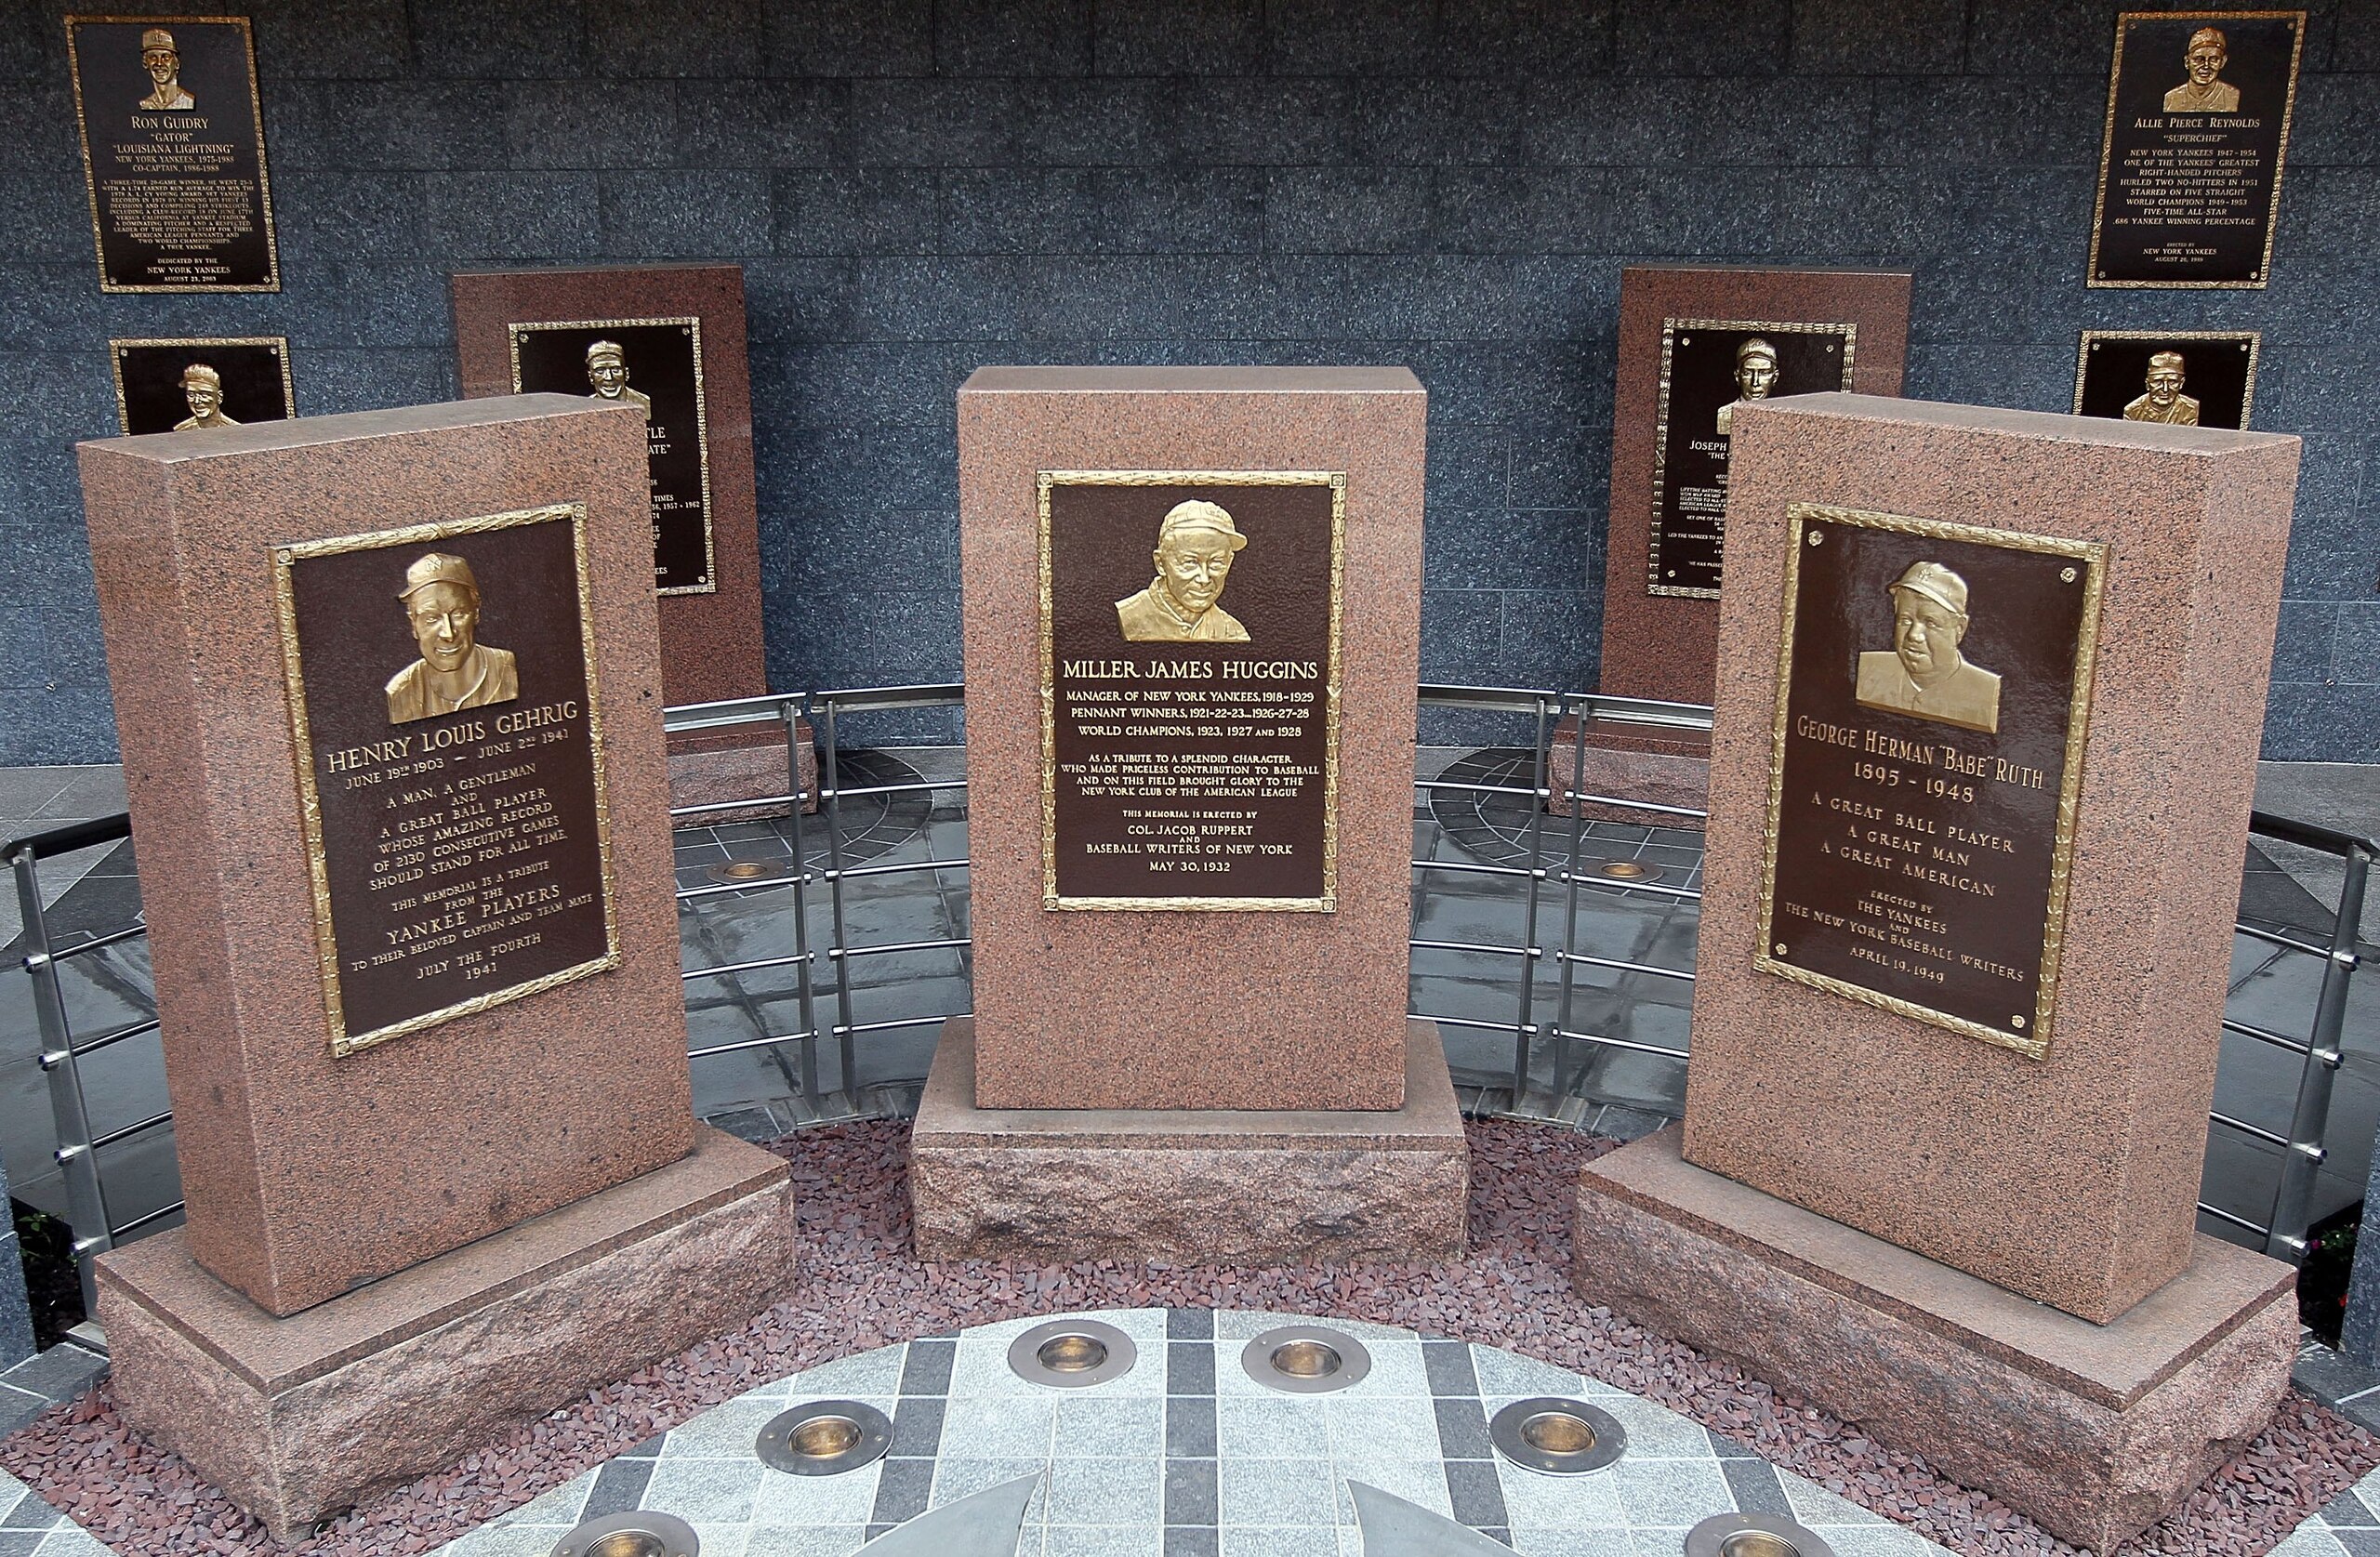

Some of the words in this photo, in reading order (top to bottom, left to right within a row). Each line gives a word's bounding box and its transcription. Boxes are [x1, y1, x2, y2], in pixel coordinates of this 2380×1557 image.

[131, 116, 158, 128] RON
[163, 116, 208, 129] GUIDRY
[2134, 117, 2162, 128] ALLIE
[2169, 117, 2203, 127] PIERCE
[2209, 117, 2260, 127] REYNOLDS
[1689, 440, 1727, 451] JOSEPH
[653, 494, 674, 502] TIMES
[1063, 660, 1141, 678] MILLER
[1144, 660, 1212, 679] JAMES
[1222, 661, 1317, 679] HUGGINS
[1066, 691, 1122, 701] MANAGER
[1124, 691, 1139, 701] OF
[1143, 691, 1171, 701] NEW
[1174, 691, 1207, 702] YORK
[1071, 707, 1127, 718] PENNANT
[325, 736, 412, 773] HENRY
[421, 721, 485, 752] LOUIS
[496, 701, 577, 733] GEHRIG
[1078, 725, 1121, 735] WORLD
[1125, 725, 1194, 736] CHAMPIONS,
[1197, 726, 1223, 736] 1923,
[1227, 726, 1252, 736] 1927
[1277, 726, 1302, 736] 1928
[345, 772, 382, 790] JUNE
[413, 758, 444, 773] 1903
[478, 742, 511, 759] JUNE
[542, 728, 568, 744] 1941
[1088, 754, 1100, 762] AS
[1103, 754, 1110, 762] A
[1112, 754, 1152, 763] TRIBUTE
[1155, 754, 1169, 763] TO
[1170, 754, 1178, 763] A
[1181, 754, 1228, 763] SPLENDID
[1232, 754, 1292, 763] CHARACTER
[1797, 715, 1858, 748] GEORGE
[1865, 730, 1935, 764] HERMAN
[1995, 758, 2043, 789] RUTH
[386, 798, 397, 809] A
[443, 784, 454, 795] A
[458, 762, 536, 790] GENTLEMAN
[1061, 764, 1087, 773] WHO
[1090, 764, 1117, 773] MADE
[1122, 764, 1169, 773] PRICELESS
[1172, 765, 1250, 774] CONTRIBUTION
[1254, 765, 1269, 774] TO
[1273, 765, 1319, 774] BASEBALL
[1076, 775, 1099, 785] AND
[1103, 775, 1119, 785] ON
[1121, 776, 1144, 785] THIS
[1148, 776, 1175, 785] FIELD
[1179, 776, 1225, 785] BROUGHT
[1230, 776, 1263, 785] GLORY
[1265, 777, 1280, 785] TO
[1282, 776, 1303, 785] THE
[1855, 761, 1899, 786] 1895
[1926, 778, 1974, 803] 1948
[1081, 786, 1105, 796] NEW
[1108, 786, 1135, 796] YORK
[1138, 786, 1162, 796] CLUB
[1165, 787, 1177, 796] OF
[1180, 787, 1199, 797] THE
[1203, 787, 1255, 797] AMERICAN
[1261, 787, 1297, 797] LEAGUE
[377, 834, 426, 854] WHOSE
[432, 816, 494, 841] AMAZING
[500, 801, 552, 824] RECORD
[380, 827, 390, 838] A
[398, 812, 443, 833] GREAT
[452, 802, 486, 820] BALL
[494, 787, 547, 809] PLAYER
[1812, 792, 1821, 805] A
[1831, 798, 1883, 820] GREAT
[1896, 813, 1936, 834] BALL
[1948, 825, 2015, 853] PLAYER
[373, 860, 390, 873] OF
[395, 851, 425, 867] 2130
[432, 826, 515, 857] CONSECUTIVE
[522, 815, 559, 833] GAMES
[1127, 825, 1154, 835] COL.
[1157, 825, 1196, 835] JACOB
[1201, 825, 1253, 835] RUPPERT
[1848, 825, 1858, 838] A
[1867, 830, 1922, 853] GREAT
[1932, 846, 1969, 866] MAN
[369, 868, 423, 891] SHOULD
[430, 854, 471, 874] STAND
[478, 846, 504, 862] FOR
[508, 839, 530, 853] ALL
[1086, 843, 1141, 853] BASEBALL
[1145, 843, 1200, 854] WRITERS
[1205, 844, 1221, 854] OF
[1225, 844, 1255, 854] NEW
[1259, 844, 1292, 854] YORK
[1149, 861, 1175, 871] MAY
[1180, 861, 1200, 872] 30,
[1203, 862, 1230, 872] 1932
[1820, 842, 1831, 853] A
[1840, 847, 1892, 869] GREAT
[1902, 863, 1995, 896] AMERICAN
[386, 911, 467, 944] YANKEE
[481, 884, 560, 917] PLAYERS
[1858, 901, 1882, 916] THE
[1886, 908, 1947, 934] YANKEES
[416, 959, 449, 979] JULY
[456, 950, 483, 966] THE
[490, 932, 541, 957] FOURTH
[1786, 902, 1808, 917] THE
[1813, 910, 1844, 927] NEW
[1849, 920, 1885, 941] YORK
[1890, 934, 1952, 960] BASEBALL
[1960, 954, 2023, 982] WRITERS
[466, 964, 496, 980] 1941
[1849, 947, 1889, 966] APRIL
[1913, 965, 1944, 983] 1949
